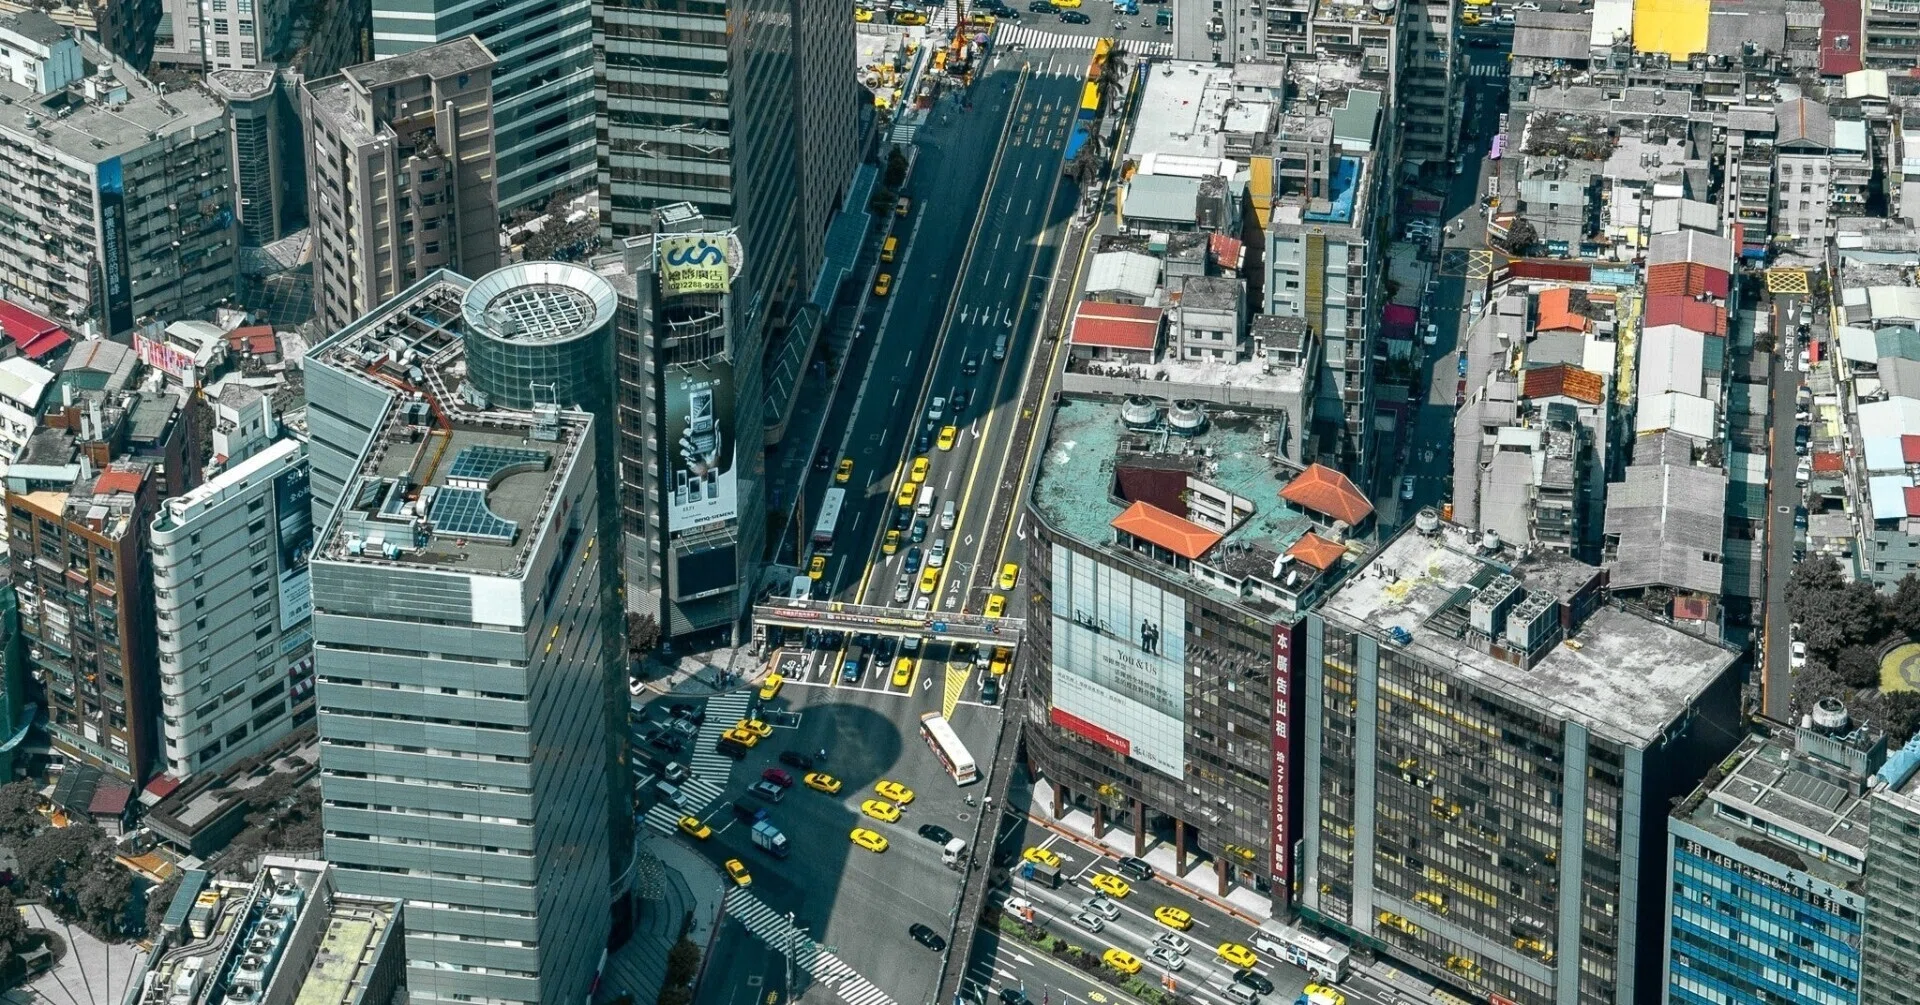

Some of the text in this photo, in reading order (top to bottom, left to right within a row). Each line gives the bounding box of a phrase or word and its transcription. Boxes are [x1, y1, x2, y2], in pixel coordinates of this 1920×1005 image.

[1118, 649, 1133, 665] You
[1136, 658, 1143, 669] &
[1145, 662, 1157, 676] Us
[1276, 633, 1288, 739] 本廣告出租
